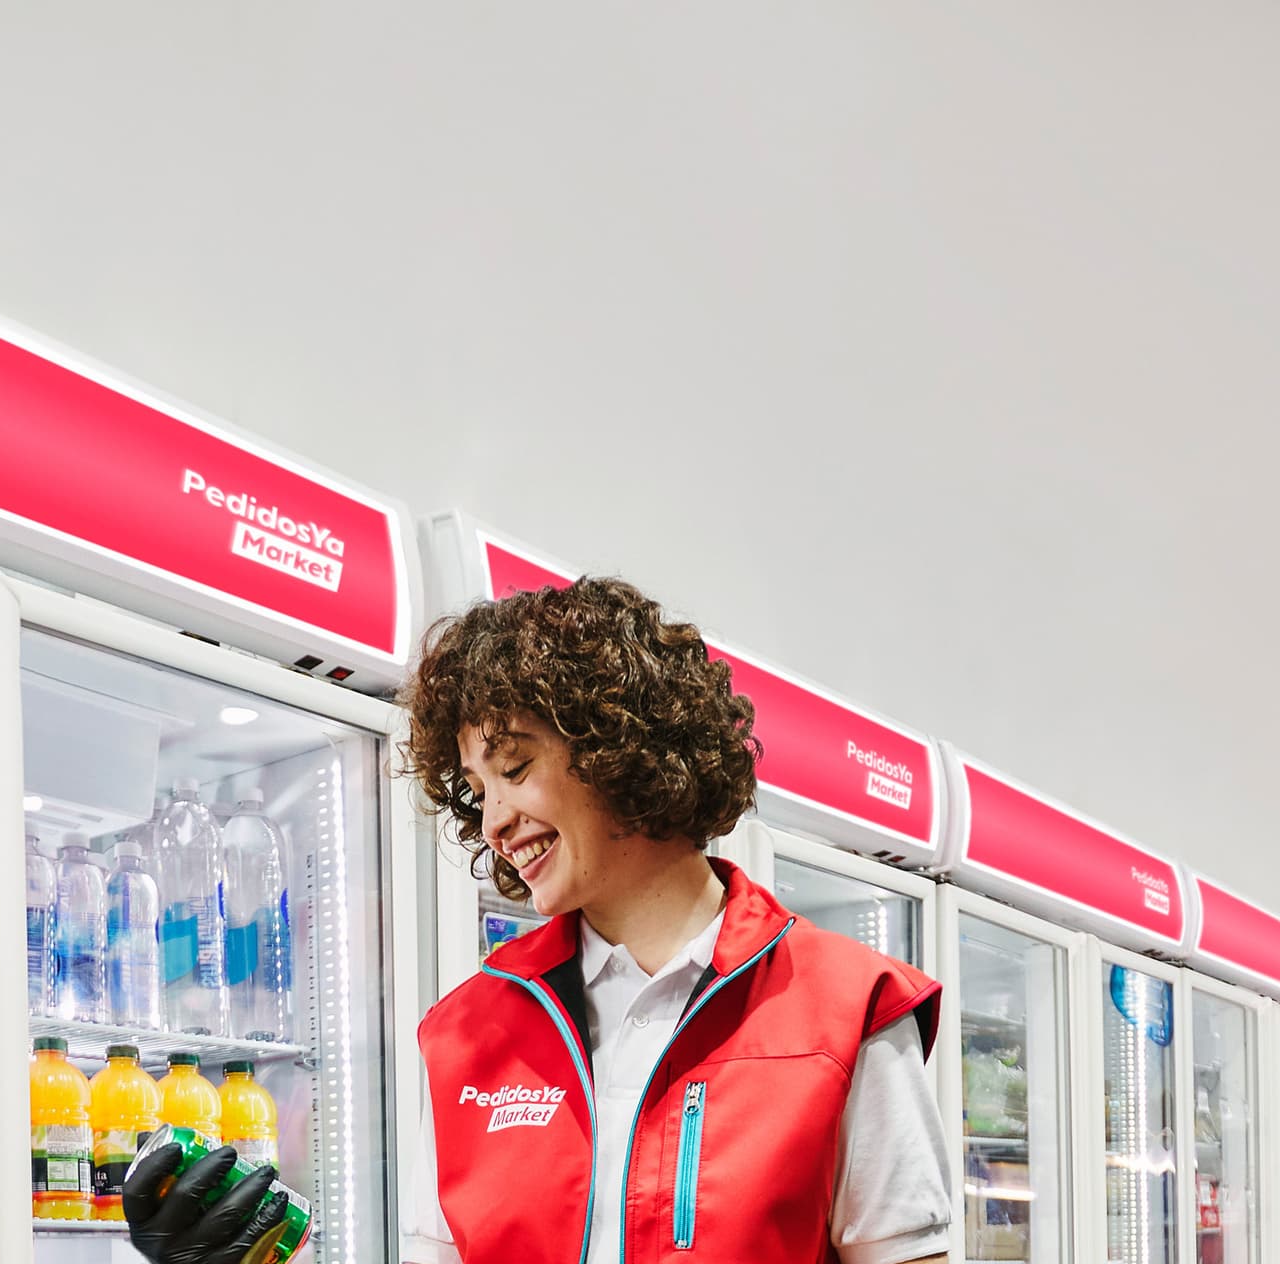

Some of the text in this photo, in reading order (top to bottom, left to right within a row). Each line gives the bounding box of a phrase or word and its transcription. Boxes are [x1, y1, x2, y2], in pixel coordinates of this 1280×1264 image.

[182, 468, 345, 557] PedidosYa
[241, 529, 335, 583] Market
[847, 740, 913, 784] PedidosYa
[870, 776, 908, 805] Market
[459, 1084, 567, 1107] PedidosYa
[492, 1106, 551, 1127] Market
